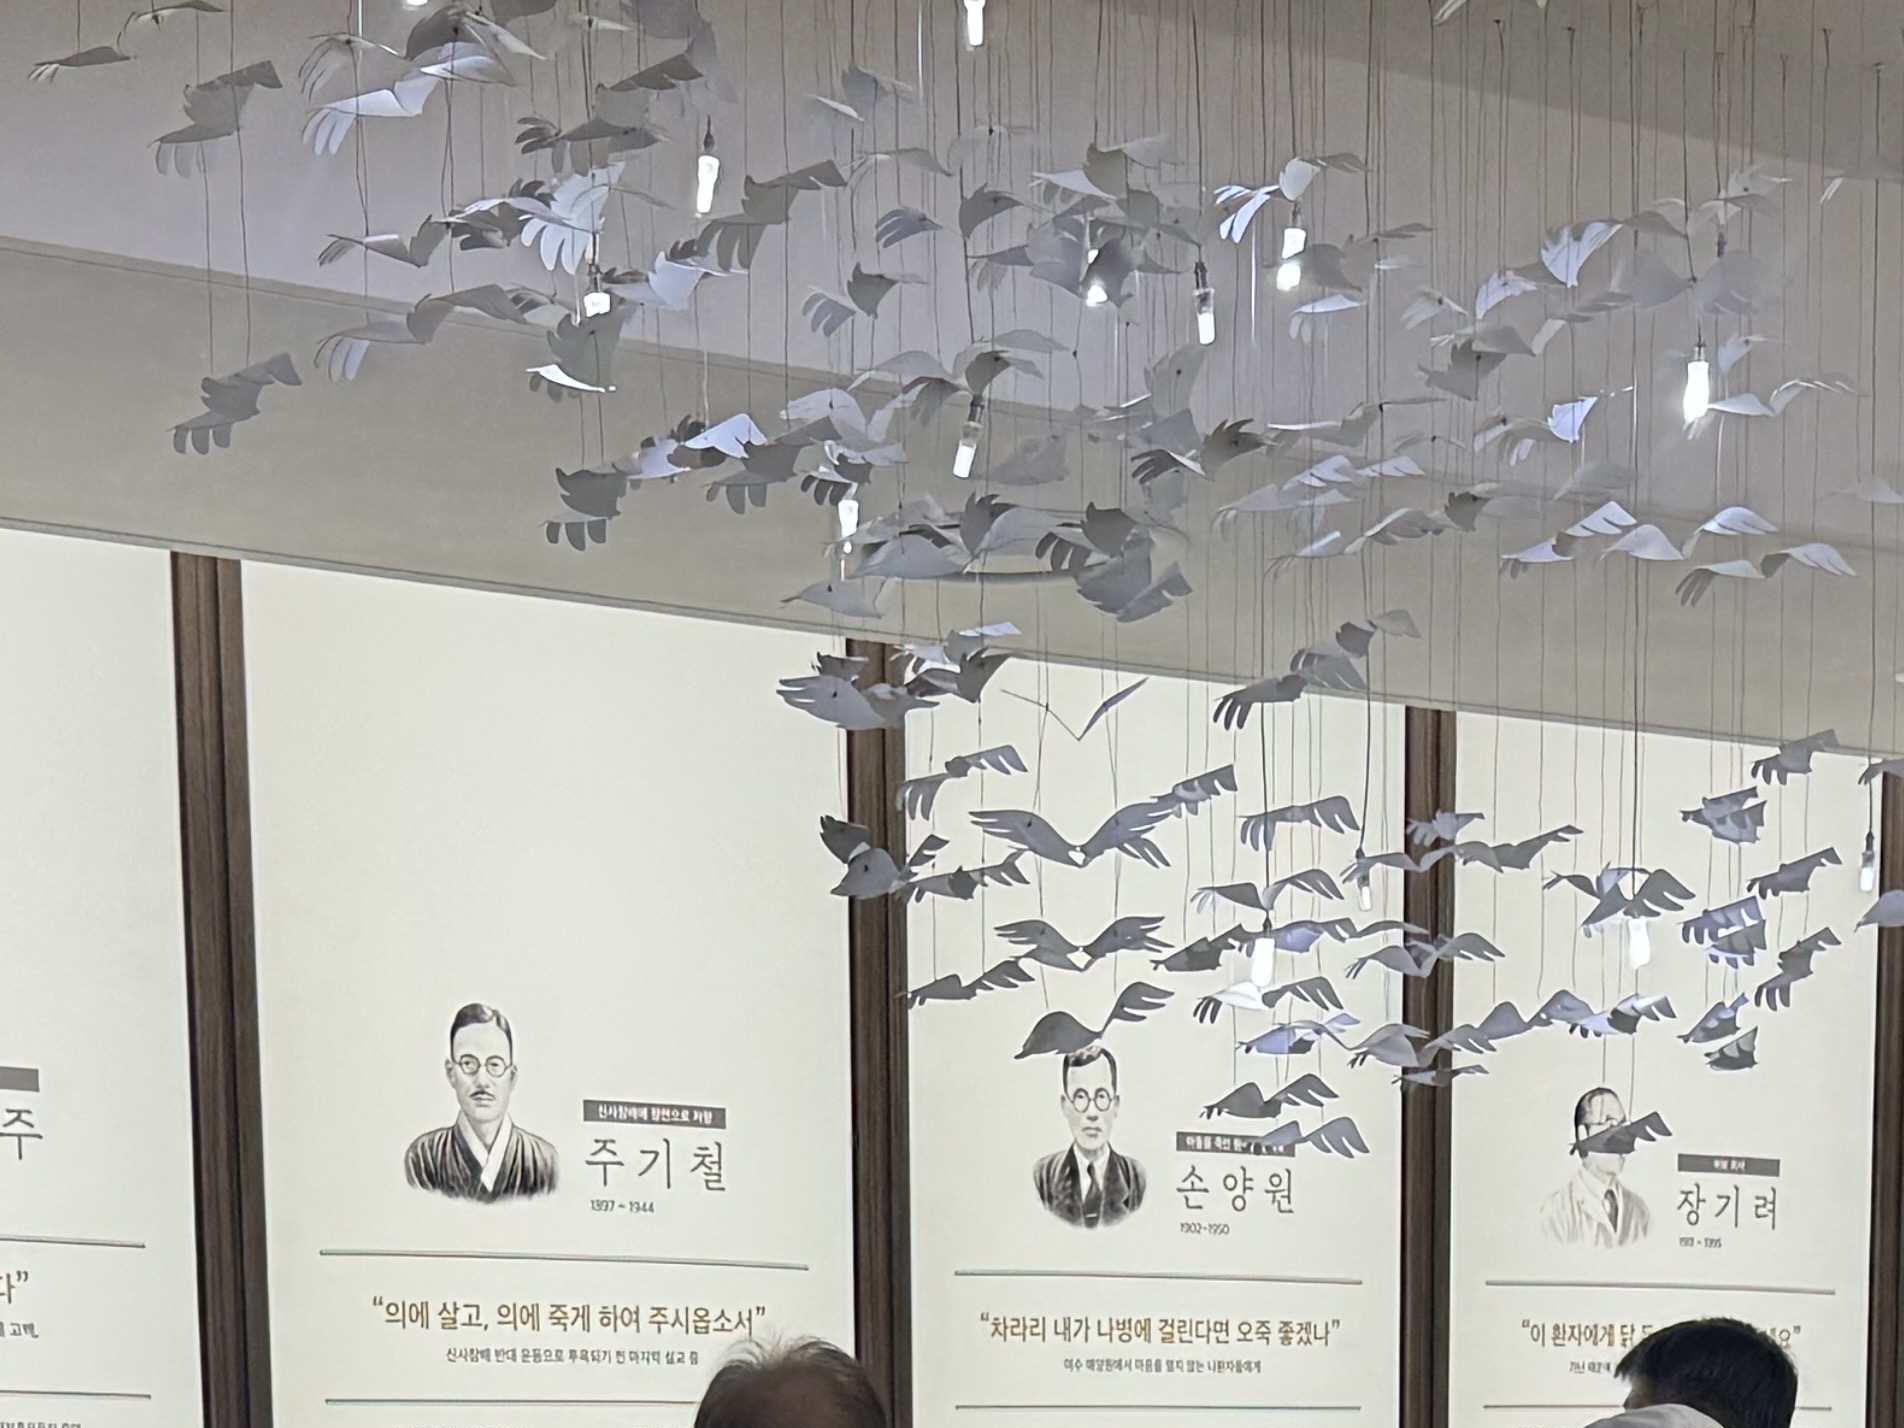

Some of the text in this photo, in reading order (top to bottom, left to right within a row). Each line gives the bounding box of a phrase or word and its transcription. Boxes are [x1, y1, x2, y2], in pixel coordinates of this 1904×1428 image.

[629, 1201, 654, 1213] 1944
[373, 1296, 765, 1340] “의에 살고, 의에 죽게 하여 주시옵소서”
[980, 1312, 1340, 1346] “차라리 내가 나병에 걸린다면 오죽 좋겠나”
[1552, 1323, 1614, 1347] 환자에게
[446, 1348, 491, 1363] 신사참배
[494, 1348, 517, 1363] 반대
[521, 1348, 564, 1363] 운동으로
